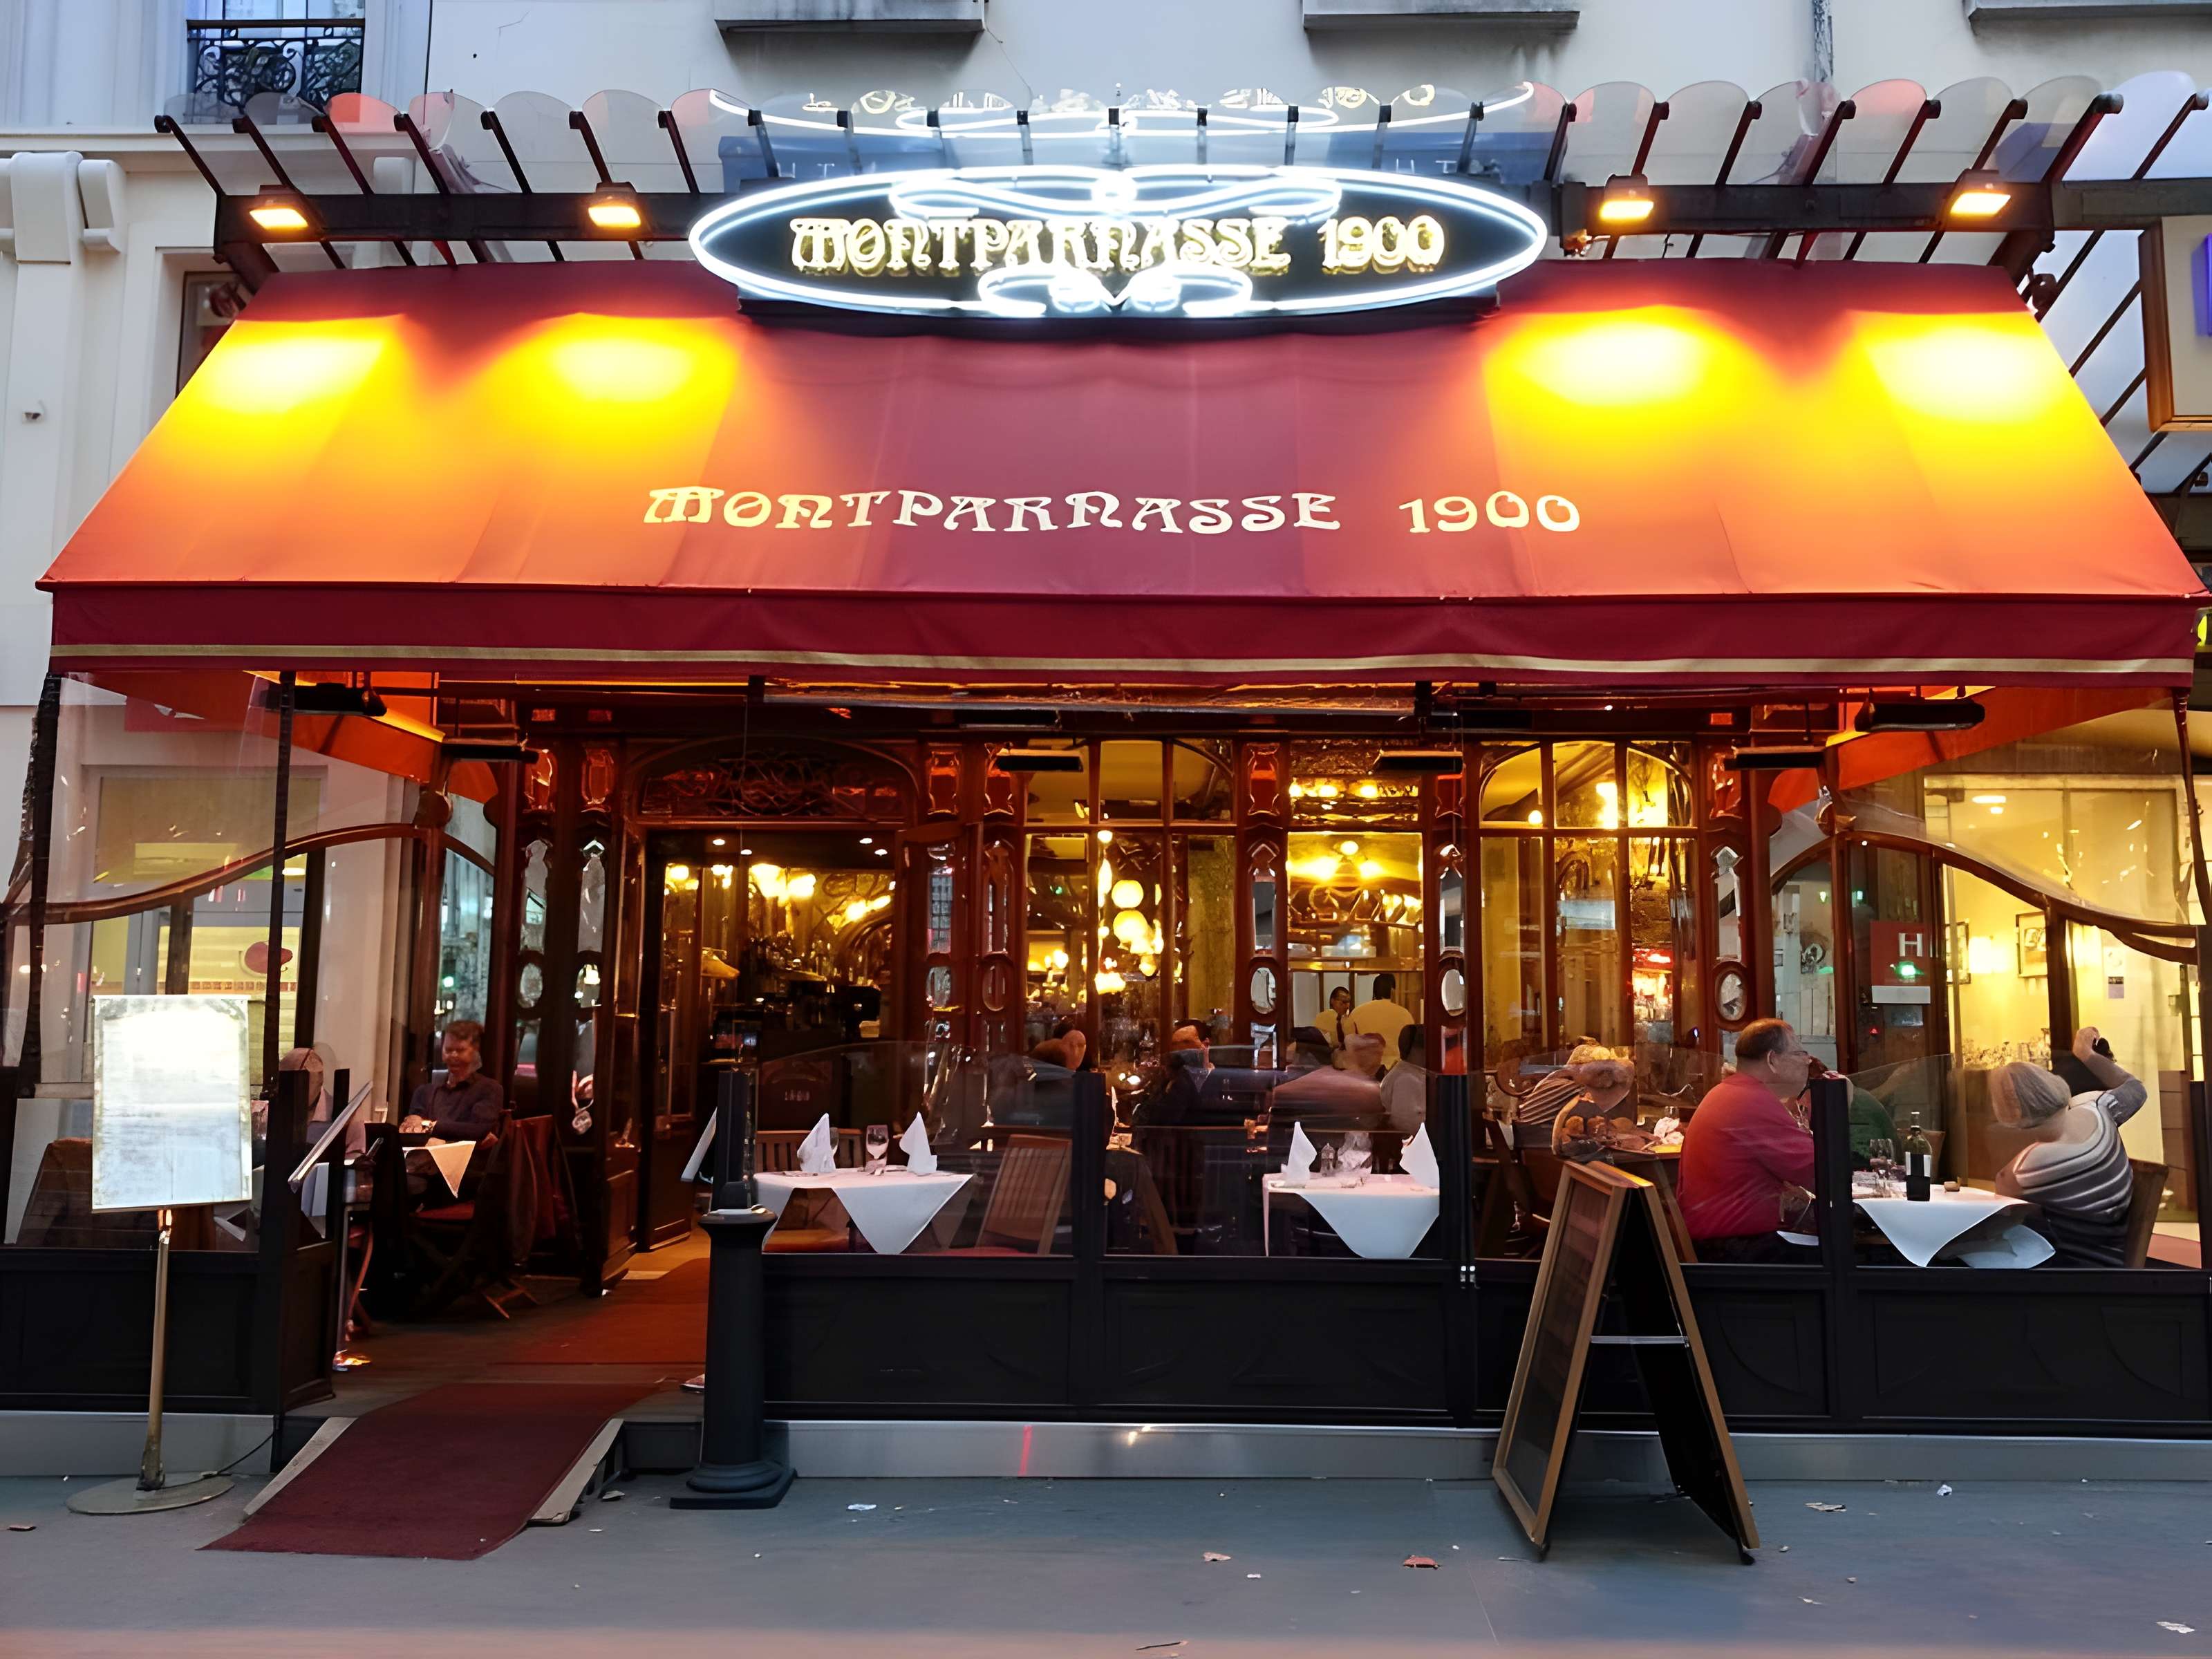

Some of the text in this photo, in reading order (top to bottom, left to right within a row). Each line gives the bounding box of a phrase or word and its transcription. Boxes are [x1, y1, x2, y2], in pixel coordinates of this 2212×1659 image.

[789, 215, 1445, 275] MONTPARNASSE 1900
[643, 485, 1581, 534] MONTPARNASSE 1900
[1897, 932, 1924, 957] H
